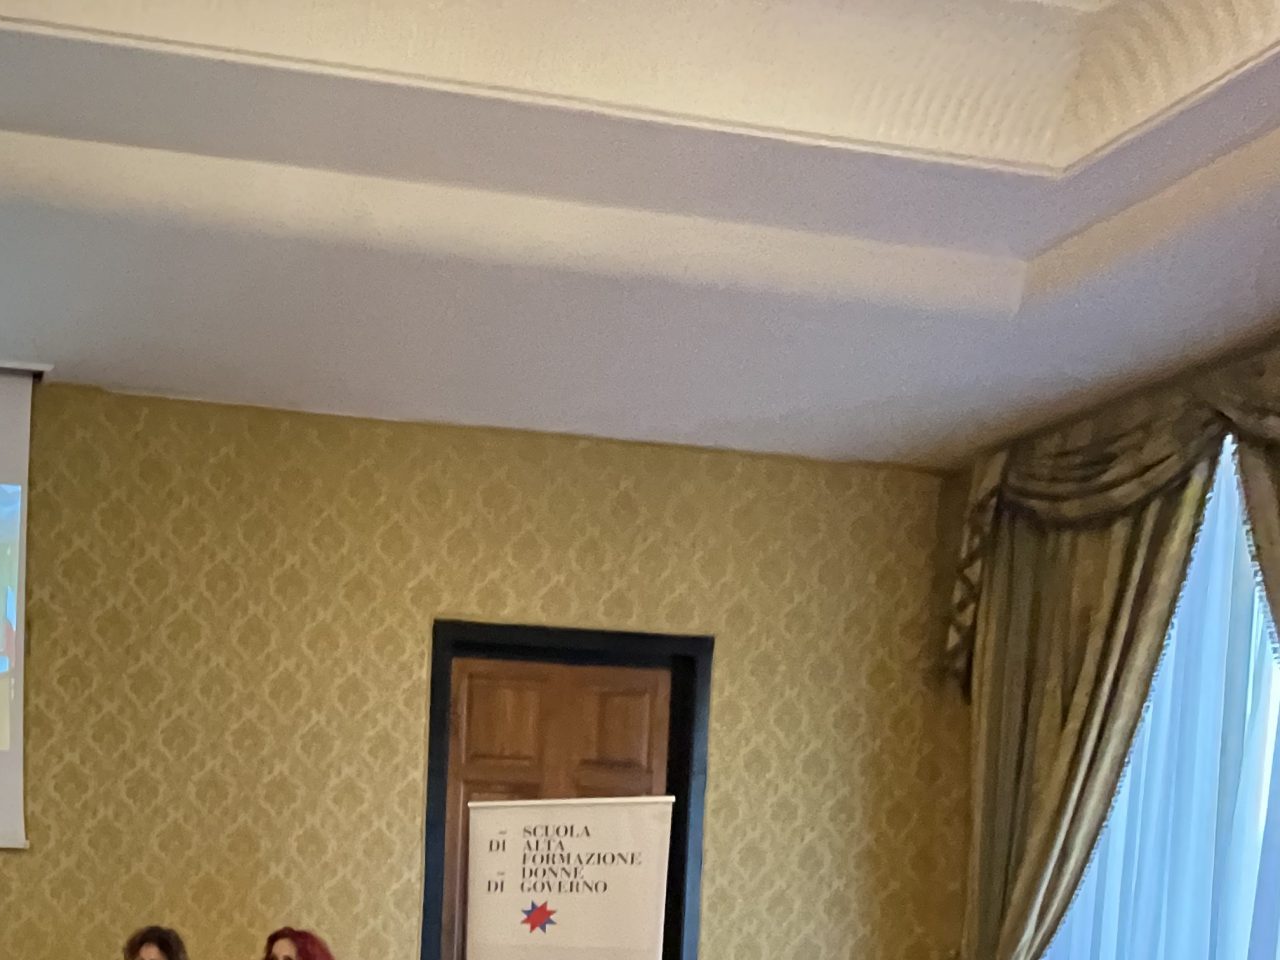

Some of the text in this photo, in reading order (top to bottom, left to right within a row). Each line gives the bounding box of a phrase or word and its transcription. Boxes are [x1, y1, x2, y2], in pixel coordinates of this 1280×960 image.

[522, 825, 591, 838] SCUOLA
[489, 839, 565, 852] DI ALTA
[522, 852, 642, 866] FORMAZIONE
[522, 867, 585, 879] DONNE
[487, 880, 608, 893] DI GOVERNO
